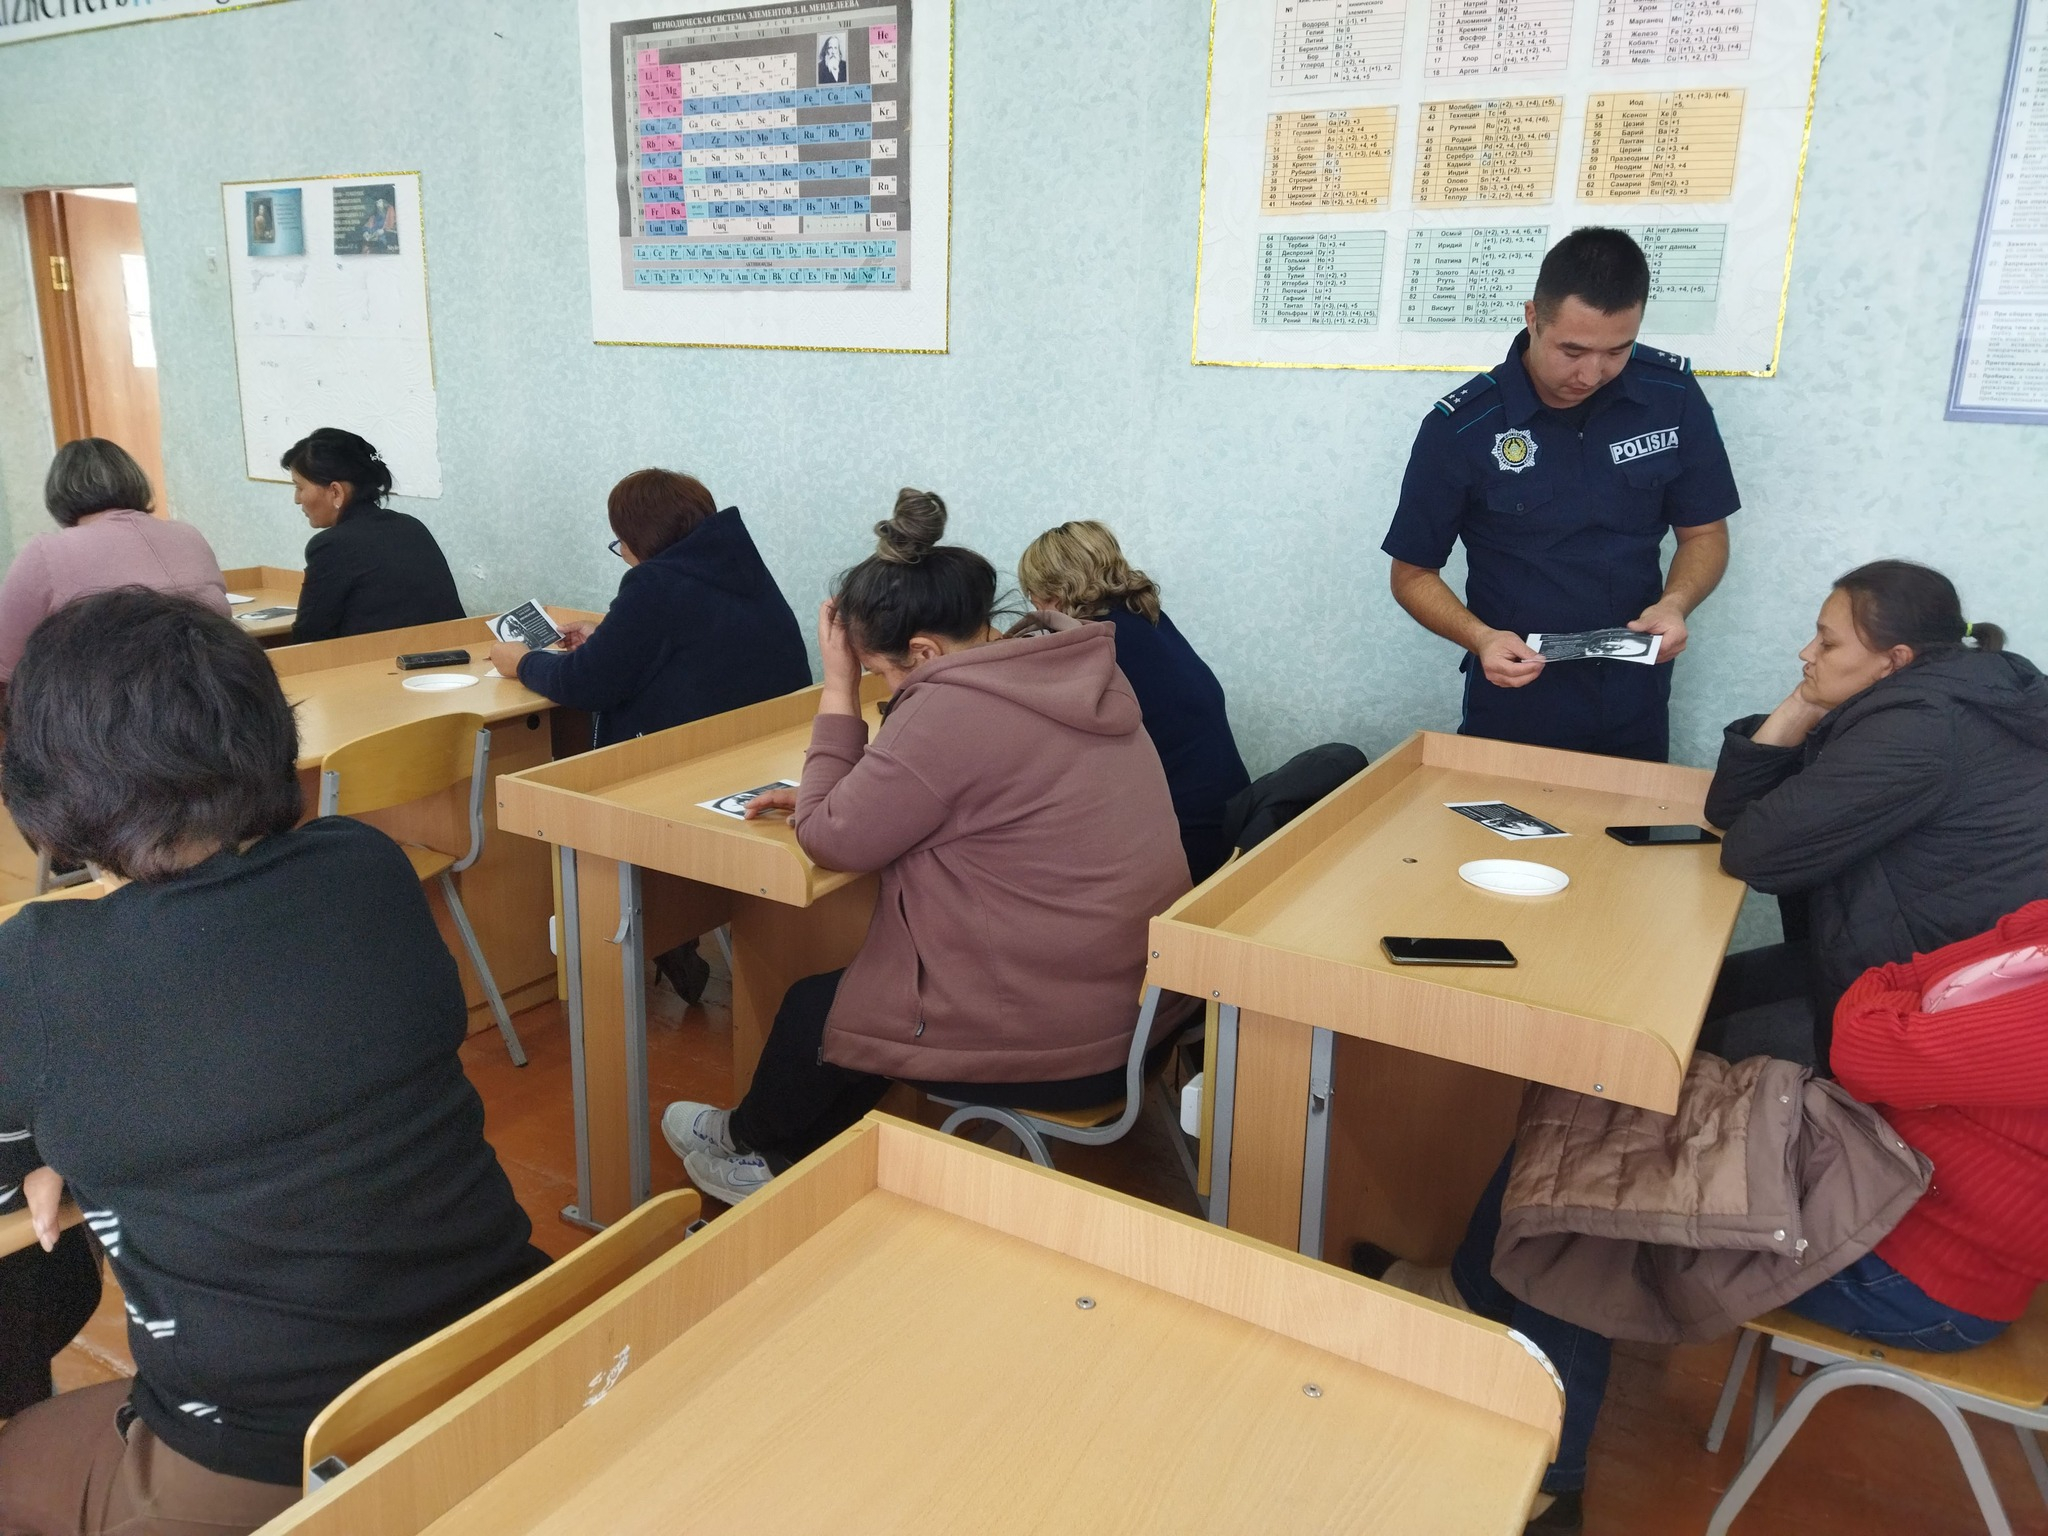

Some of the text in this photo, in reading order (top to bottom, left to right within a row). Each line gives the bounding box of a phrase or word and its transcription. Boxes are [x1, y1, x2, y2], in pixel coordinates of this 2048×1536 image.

[653, 16, 711, 30] ПЕРИОДИЧЕСКАЯ
[712, 13, 747, 23] СИСТЕМА
[748, 7, 792, 20] ЭЛЕМЕНТОВ
[809, 0, 860, 13] МЕНДЕЛЕЕВА
[877, 31, 889, 40] He
[878, 50, 889, 59] Ne
[781, 77, 789, 85] Cl
[879, 70, 889, 78] Ar
[804, 90, 863, 102] Fe Co Ni
[689, 107, 889, 128] Ga Ge As Br Kr
[1623, 120, 1644, 128] Цезий
[711, 128, 865, 144] Zr Mo Ru Rh Pd
[735, 153, 744, 161] Sb
[879, 145, 889, 153] Xe
[782, 165, 863, 176] Re Os Ir Pt
[736, 188, 744, 196] Bi
[878, 182, 889, 190] Rn
[854, 201, 864, 209] Ds
[712, 218, 891, 231] Uuq Uuo
[1612, 431, 1679, 461] POLISIA
